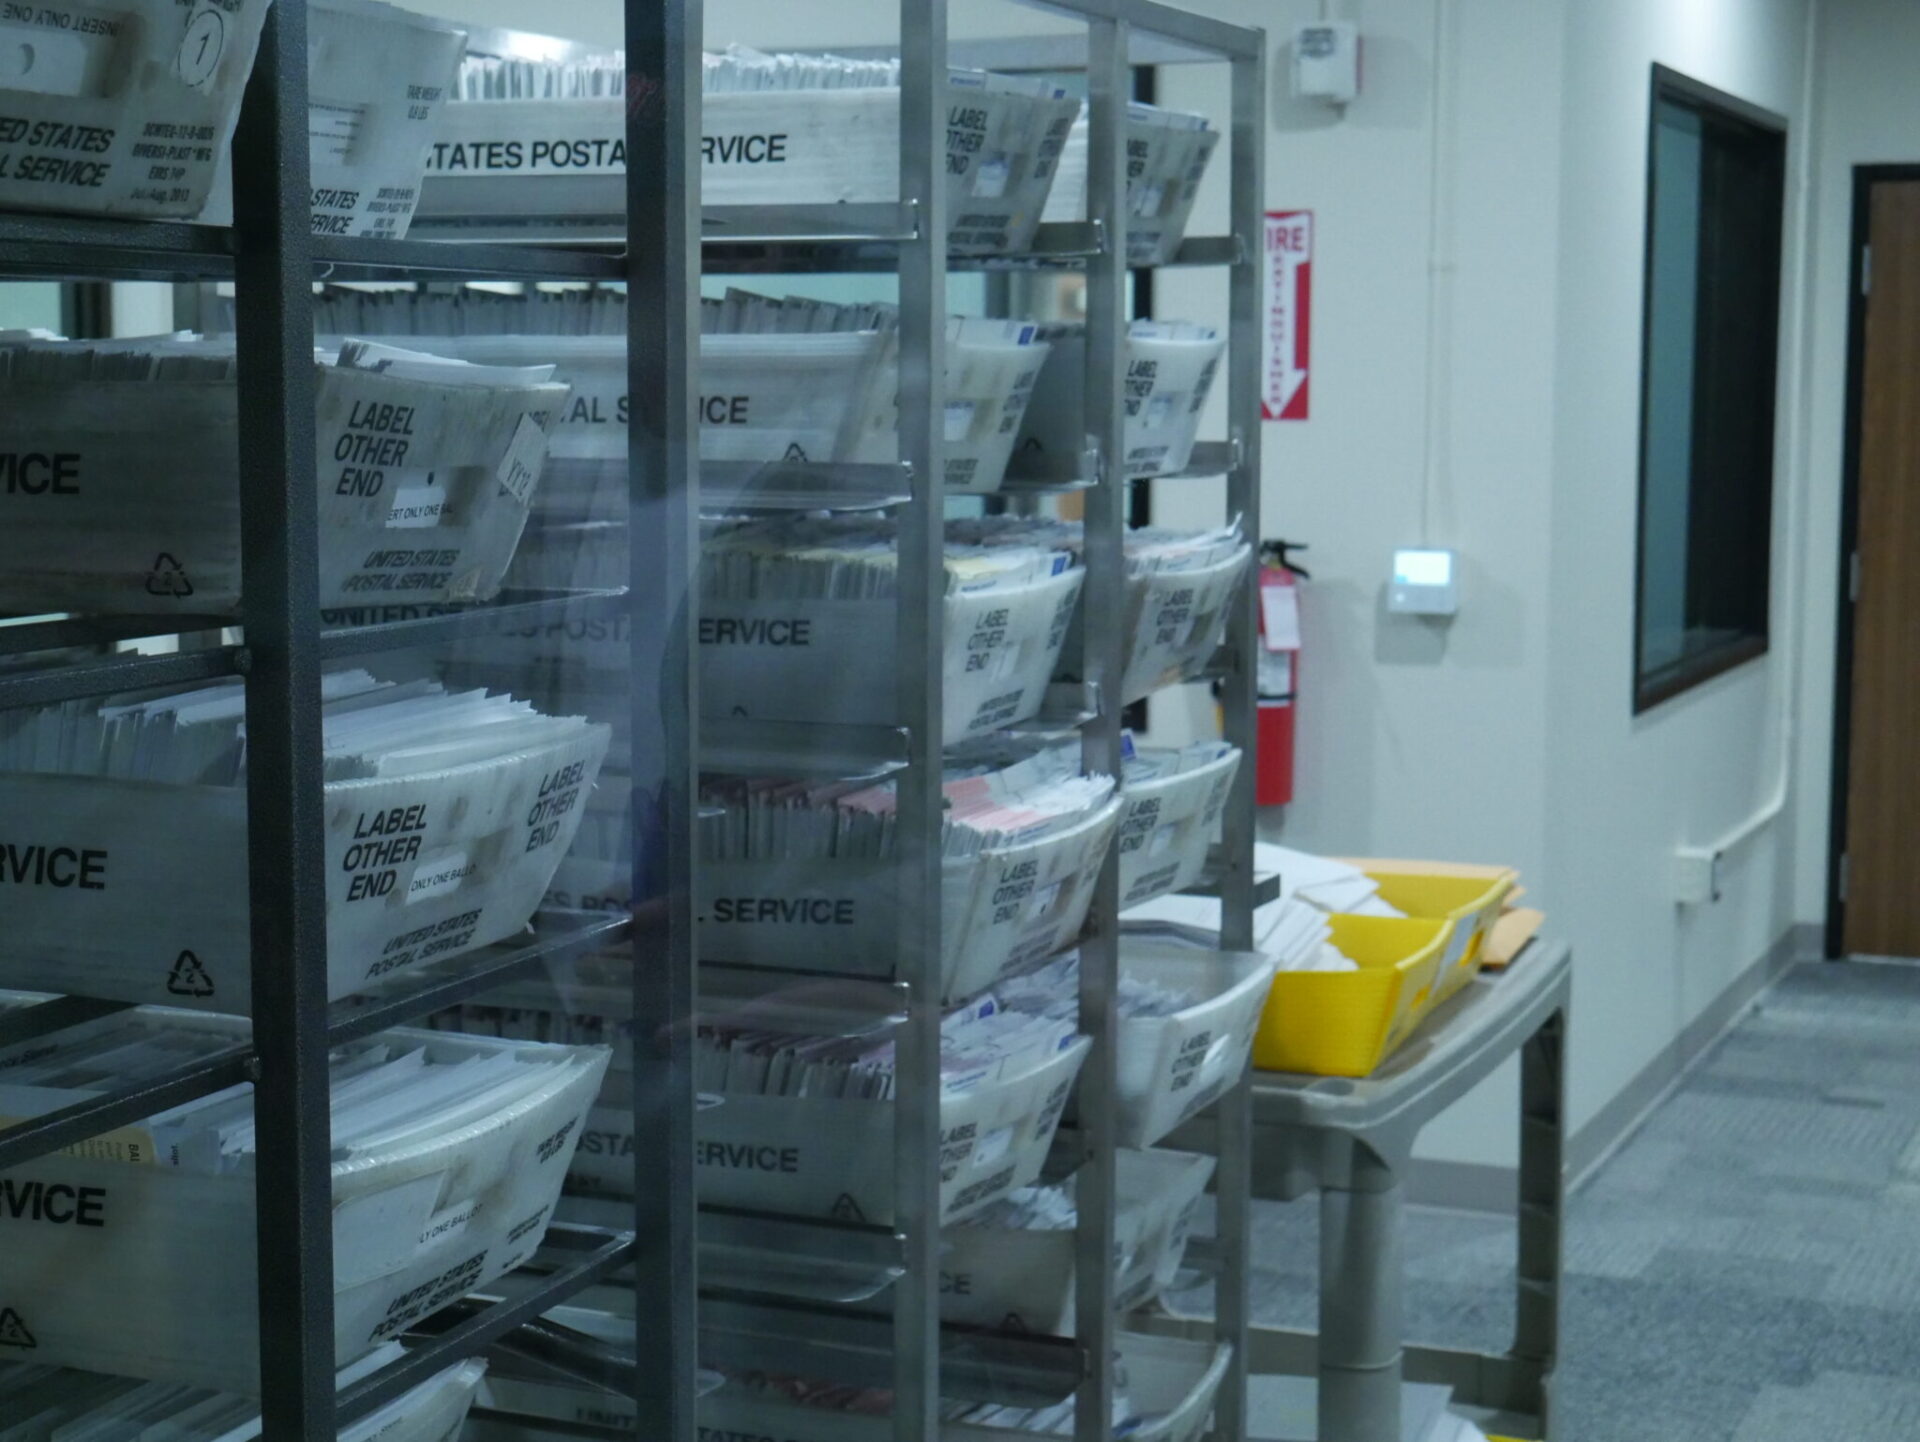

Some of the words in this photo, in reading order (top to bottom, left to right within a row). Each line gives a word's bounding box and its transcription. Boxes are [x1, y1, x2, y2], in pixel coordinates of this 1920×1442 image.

[2, 3, 33, 22] ONE
[35, 9, 71, 29] ONLY
[195, 33, 210, 65] 1
[950, 106, 988, 131] LABEL
[28, 121, 116, 154] STATES
[427, 142, 523, 170] TATES
[531, 139, 627, 167] POSTA
[13, 155, 112, 188] SERVICE
[311, 189, 359, 209] STATES
[348, 400, 415, 435] LABEL
[560, 396, 607, 424] AL
[334, 433, 409, 467] OTHER
[0, 453, 81, 495] ICE
[336, 467, 384, 497] END
[404, 506, 424, 520] ONLY
[424, 504, 440, 517] ONE
[363, 550, 415, 569] UNITED
[410, 549, 461, 567] STATES
[340, 574, 398, 592] POSTAL
[396, 572, 453, 590] SERVICE
[699, 618, 811, 646] ERVICE
[976, 608, 1010, 630] LABEL
[967, 629, 1005, 651] OTHER
[965, 652, 989, 673] END
[538, 759, 585, 798] LABEL
[527, 787, 579, 827] OTHER
[1129, 797, 1161, 817] LABEL
[353, 804, 427, 840] LABEL
[525, 820, 560, 853] END
[343, 836, 422, 872] OTHER
[410, 877, 433, 892] ONLY
[433, 871, 449, 886] ONE
[1001, 859, 1039, 883] LABEL
[347, 870, 397, 902] END
[992, 880, 1034, 905] OTHER
[713, 898, 855, 925] SERVICE
[993, 904, 1019, 925] END
[382, 924, 436, 955] UNITED
[432, 908, 482, 937] STATES
[418, 928, 476, 960] SERVICE
[0, 1178, 106, 1228] VICE
[431, 1220, 450, 1238] ONE
[387, 1276, 441, 1316] UNITED
[438, 1249, 489, 1288] STATES
[423, 1267, 483, 1312] SERVICE
